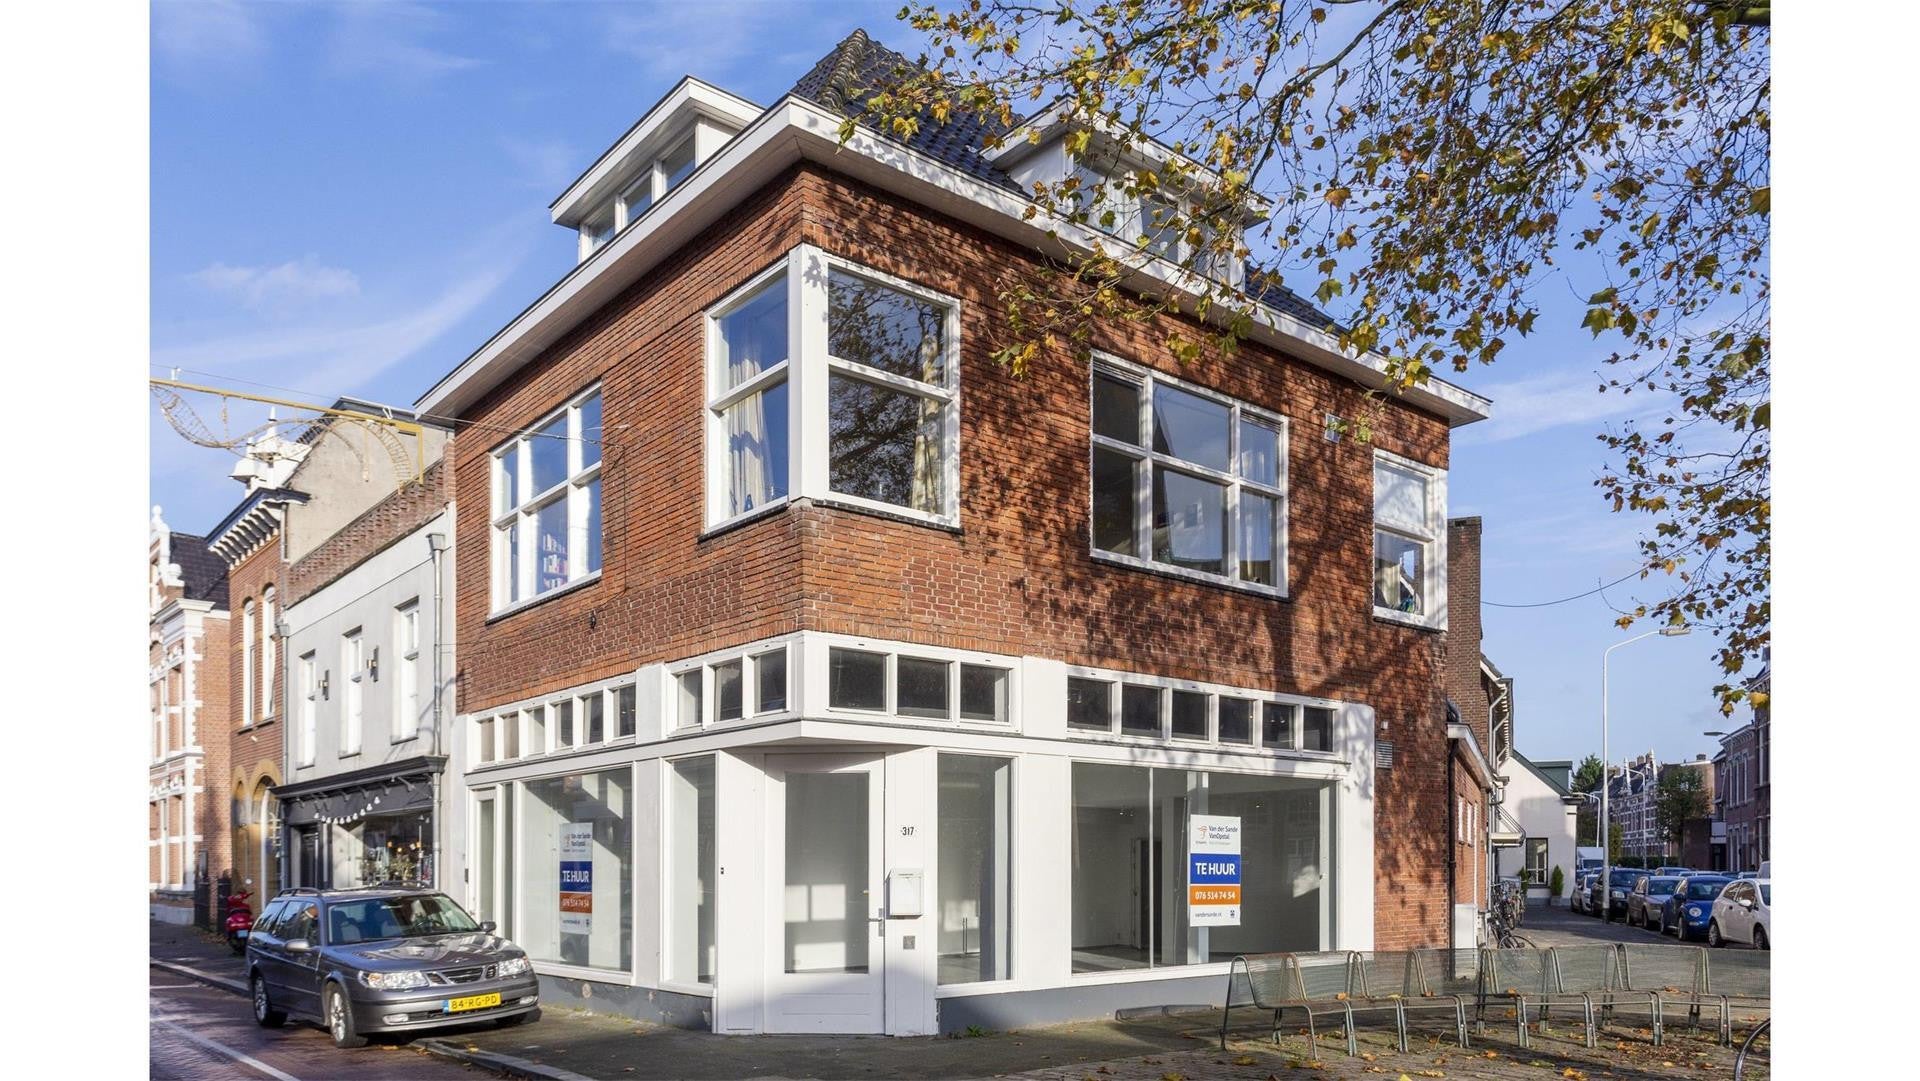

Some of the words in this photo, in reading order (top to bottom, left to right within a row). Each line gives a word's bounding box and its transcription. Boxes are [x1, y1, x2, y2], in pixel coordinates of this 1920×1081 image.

[902, 826, 915, 836] 317
[1225, 825, 1238, 833] Sande
[1195, 862, 1207, 875] TE
[1208, 862, 1236, 876] HUUR
[562, 870, 570, 882] TE
[570, 870, 589, 883] HUUR
[1207, 891, 1219, 900] 514
[1219, 891, 1227, 900] 74
[1227, 891, 1236, 900] 54
[451, 995, 498, 1010] 84-RG-PD
